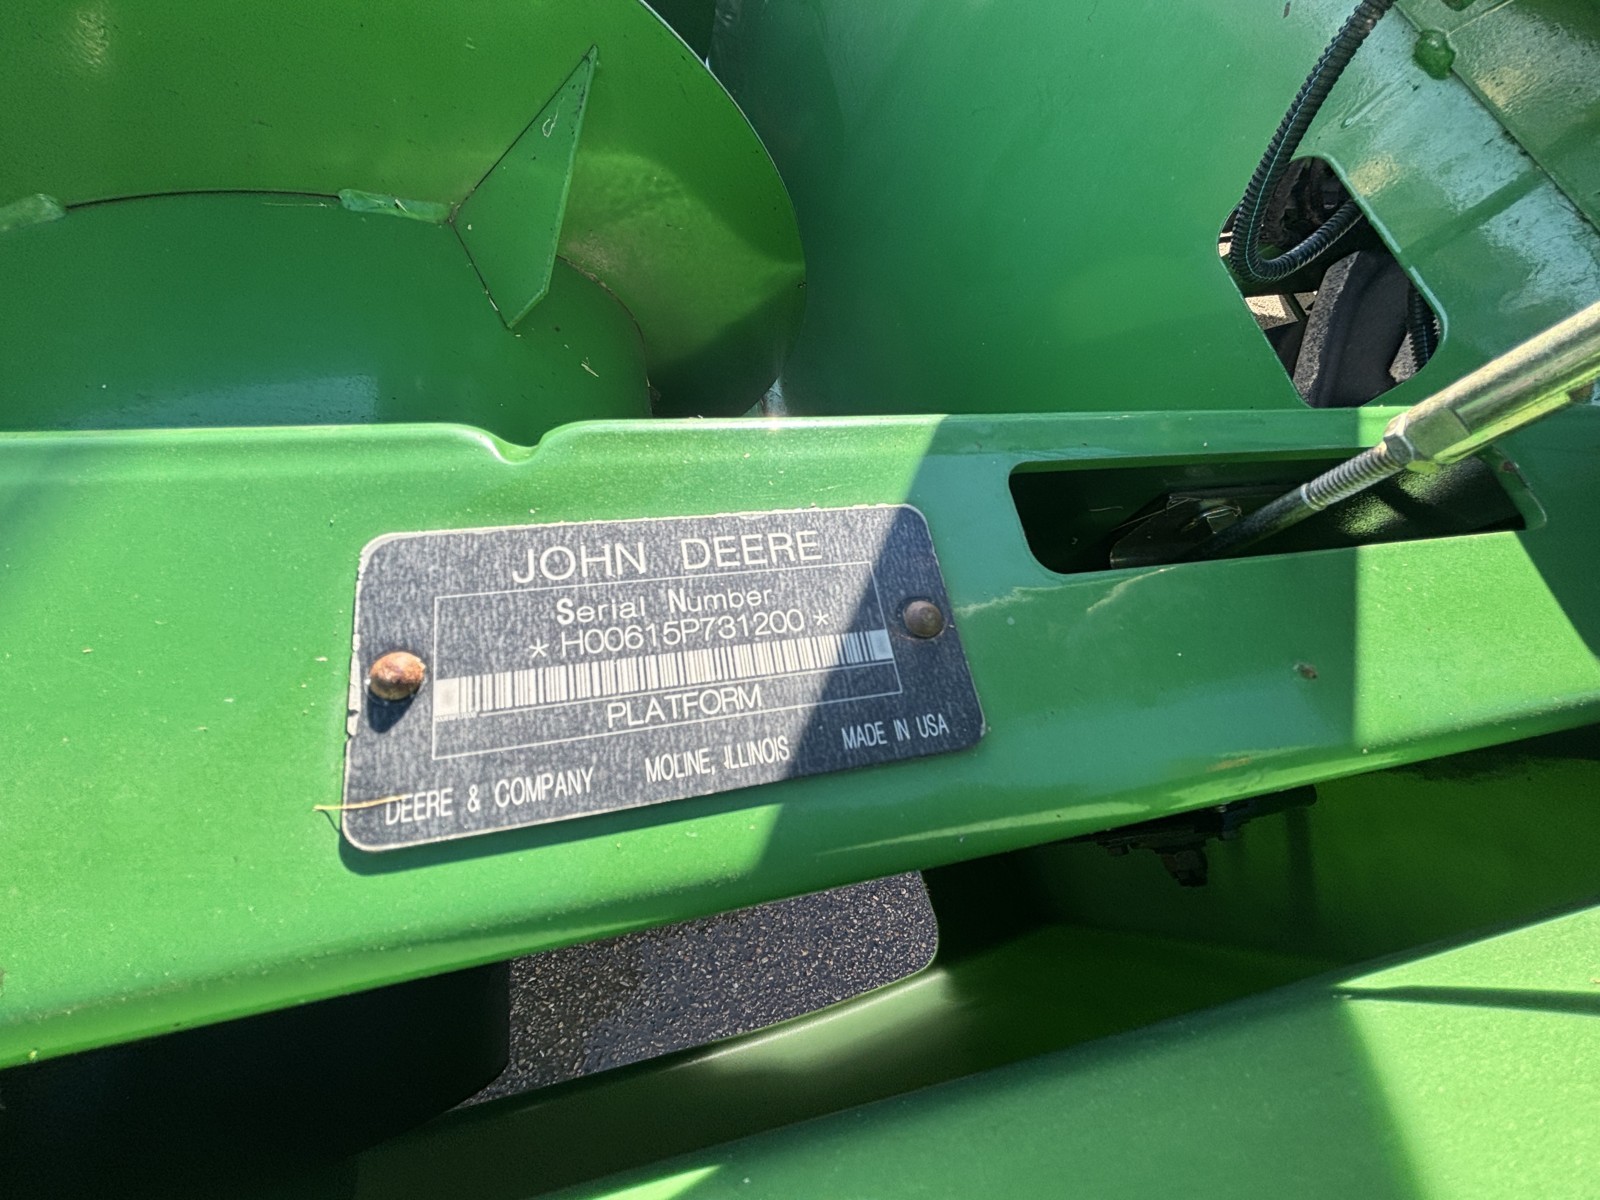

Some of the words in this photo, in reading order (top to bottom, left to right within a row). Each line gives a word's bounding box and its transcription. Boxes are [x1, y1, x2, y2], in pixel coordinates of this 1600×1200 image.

[512, 541, 646, 584] JOHN
[680, 530, 823, 570] DEERE
[556, 596, 646, 625] Serial
[668, 588, 772, 613] Number
[607, 684, 763, 729] PLATFORM
[841, 721, 886, 750] MADE
[894, 719, 911, 741] IN
[918, 713, 950, 738] USA
[644, 747, 716, 783] MOLINE,
[723, 735, 790, 770] ILLINOIS
[385, 788, 454, 826] DEERE
[467, 784, 480, 812] &
[494, 767, 594, 808] COMPANY
